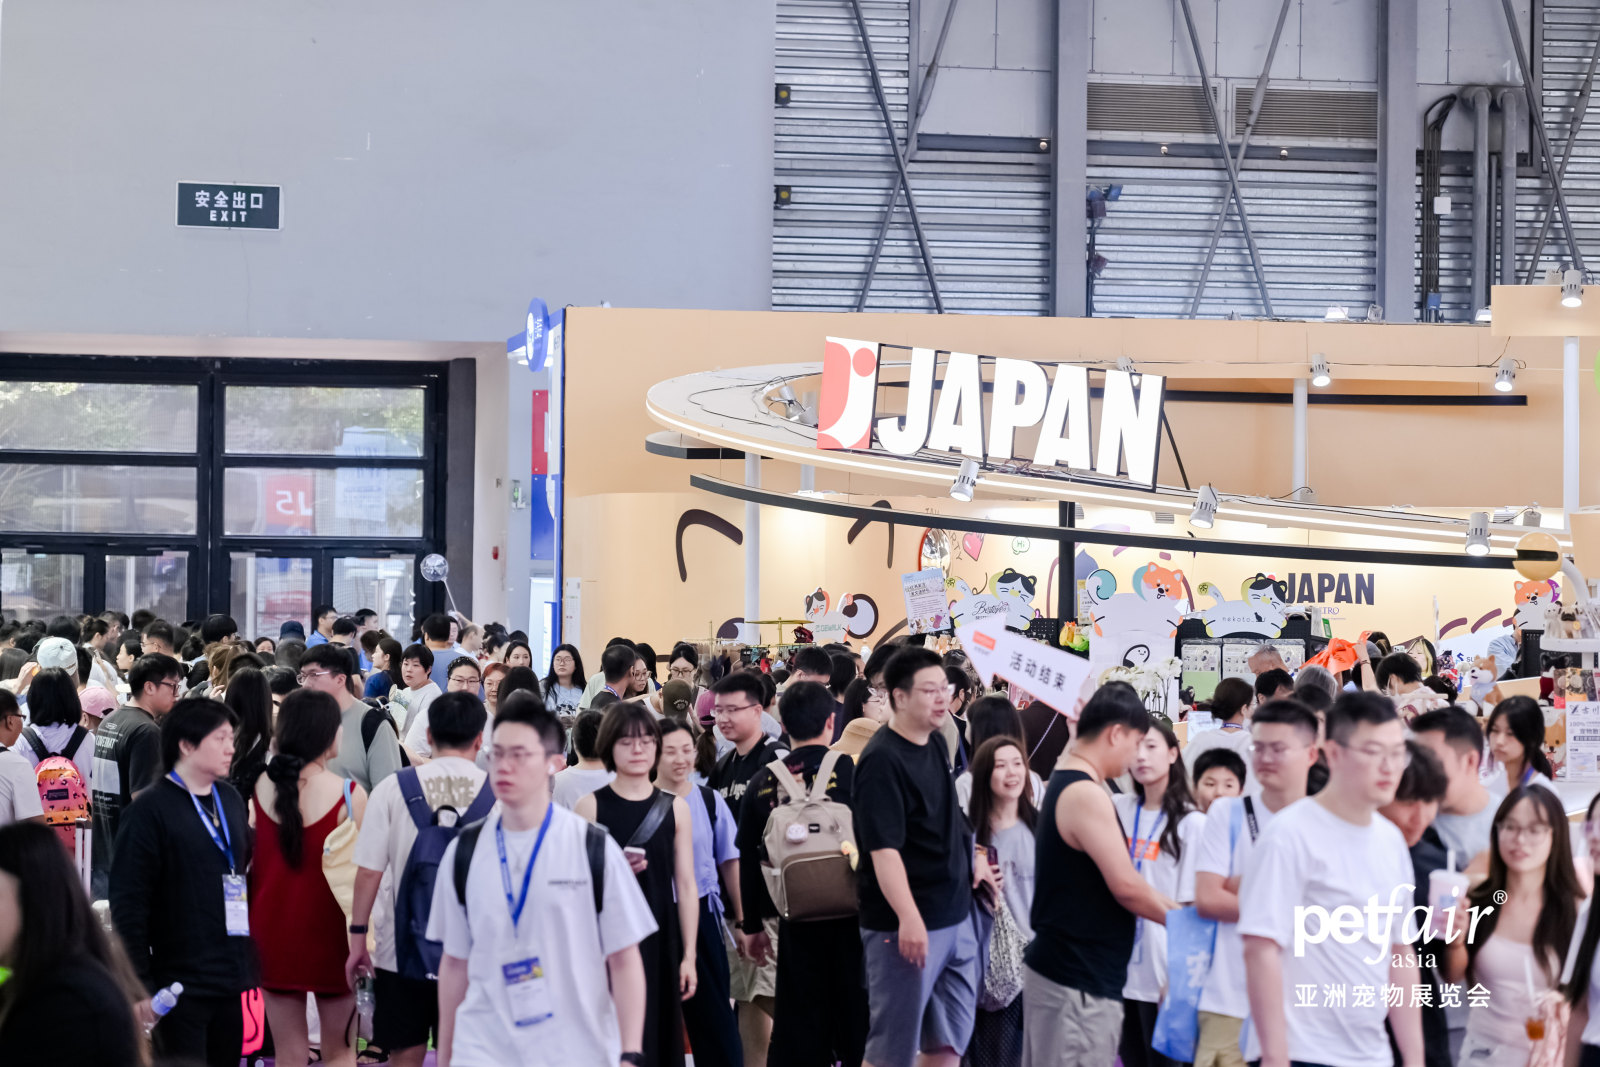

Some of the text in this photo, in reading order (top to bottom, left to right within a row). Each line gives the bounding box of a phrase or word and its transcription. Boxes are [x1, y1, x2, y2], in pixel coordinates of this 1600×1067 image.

[195, 190, 263, 209] 安全出口
[210, 210, 247, 222] EXIT
[877, 346, 1163, 488] JAPAN
[1015, 539, 1026, 549] Hi
[1286, 572, 1375, 606] JAPAN
[1009, 651, 1066, 692] 活动结束
